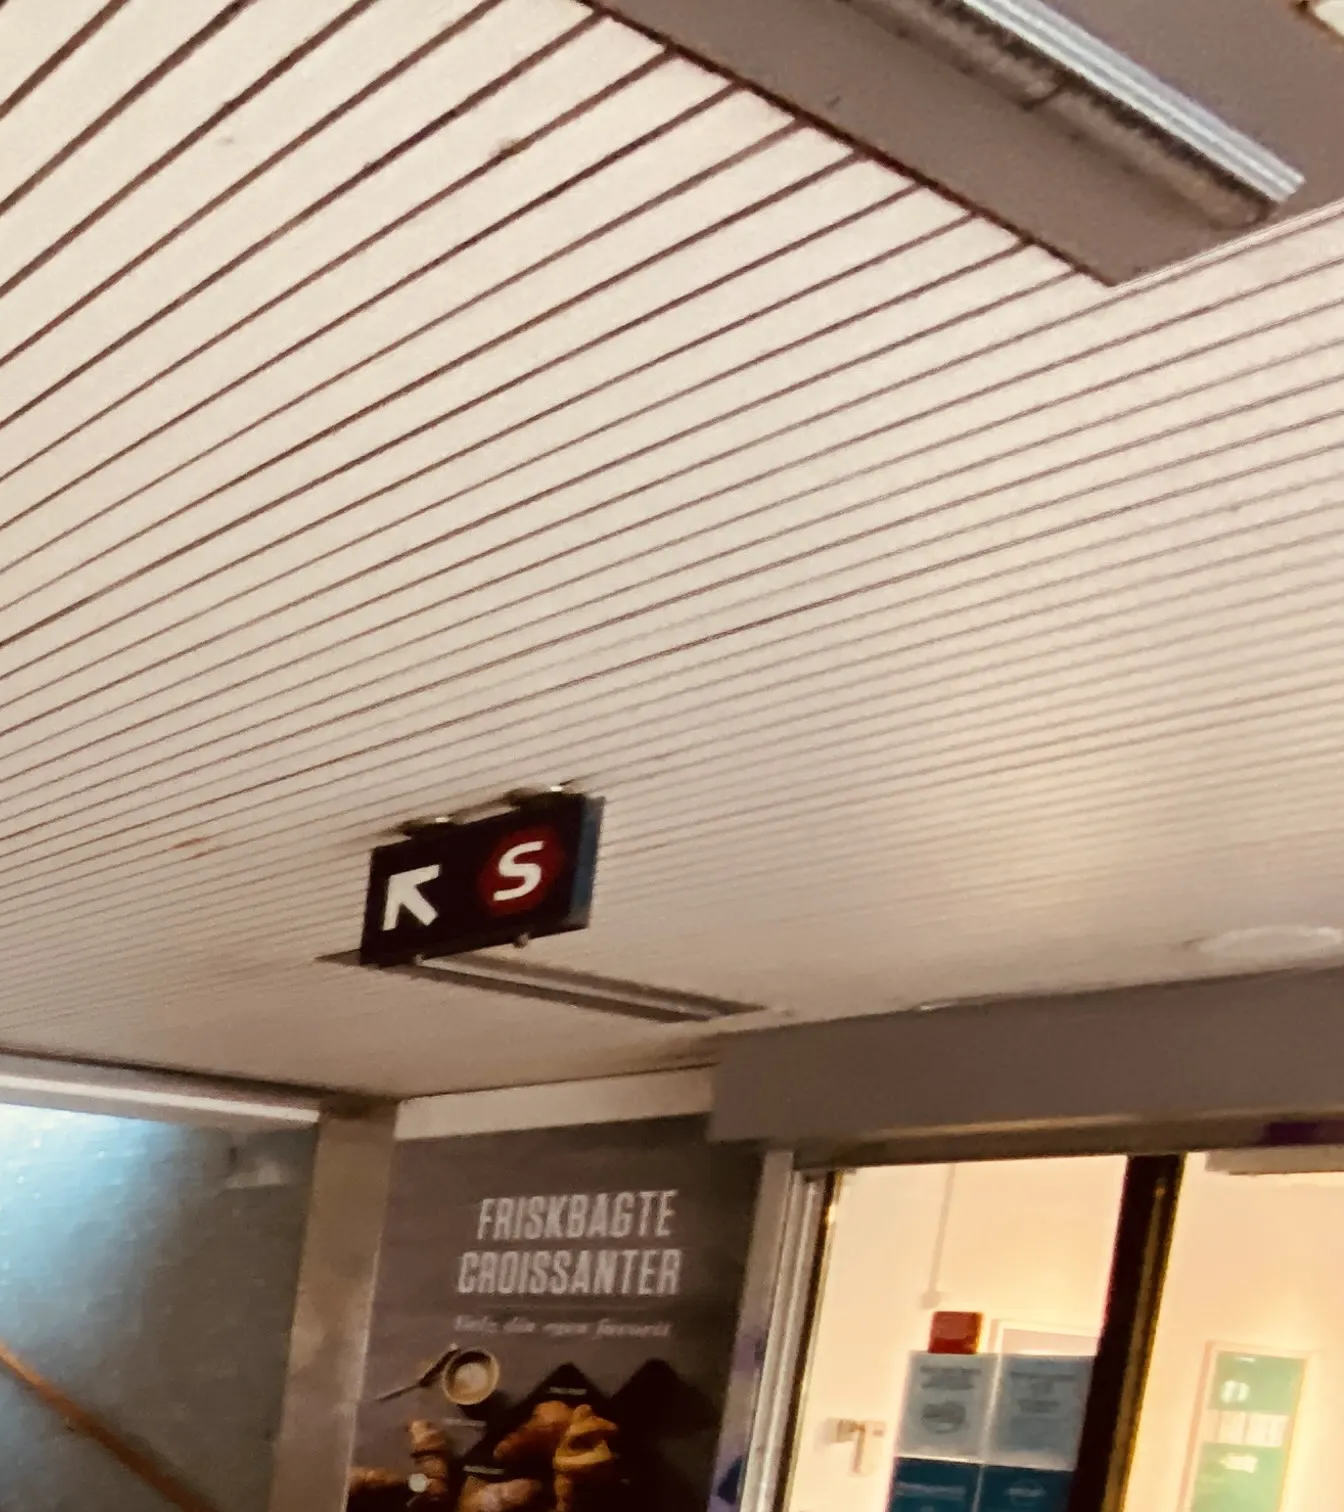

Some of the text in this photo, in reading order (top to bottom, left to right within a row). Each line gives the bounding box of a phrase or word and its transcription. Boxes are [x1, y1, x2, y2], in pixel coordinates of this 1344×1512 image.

[493, 840, 544, 901] S
[477, 1189, 679, 1240] FRISKBAGTE
[457, 1249, 683, 1295] CROISSANTER
